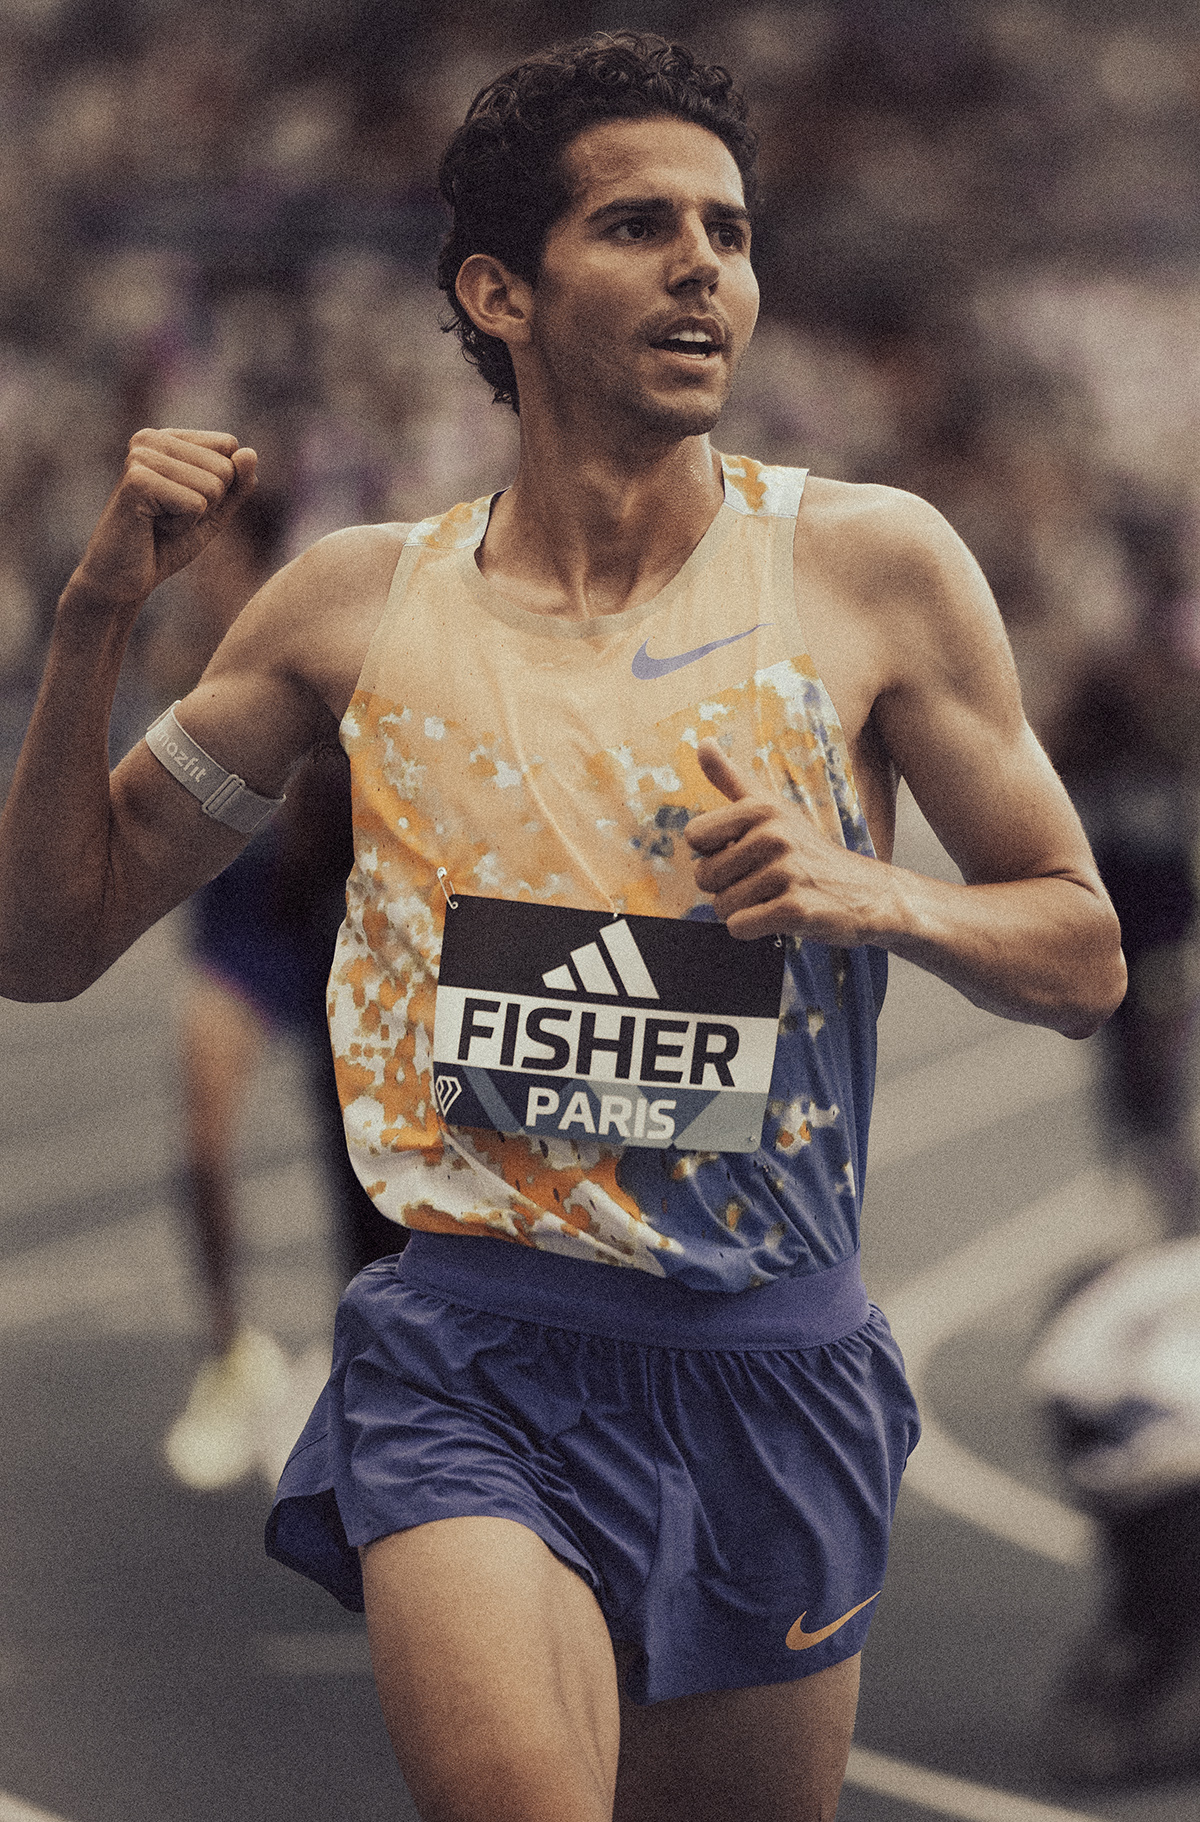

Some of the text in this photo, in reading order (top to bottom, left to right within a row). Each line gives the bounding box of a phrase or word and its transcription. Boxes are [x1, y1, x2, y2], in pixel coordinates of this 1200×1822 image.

[153, 727, 207, 783] mazfit
[457, 997, 740, 1087] FISHER
[525, 1086, 677, 1140] PARIS
